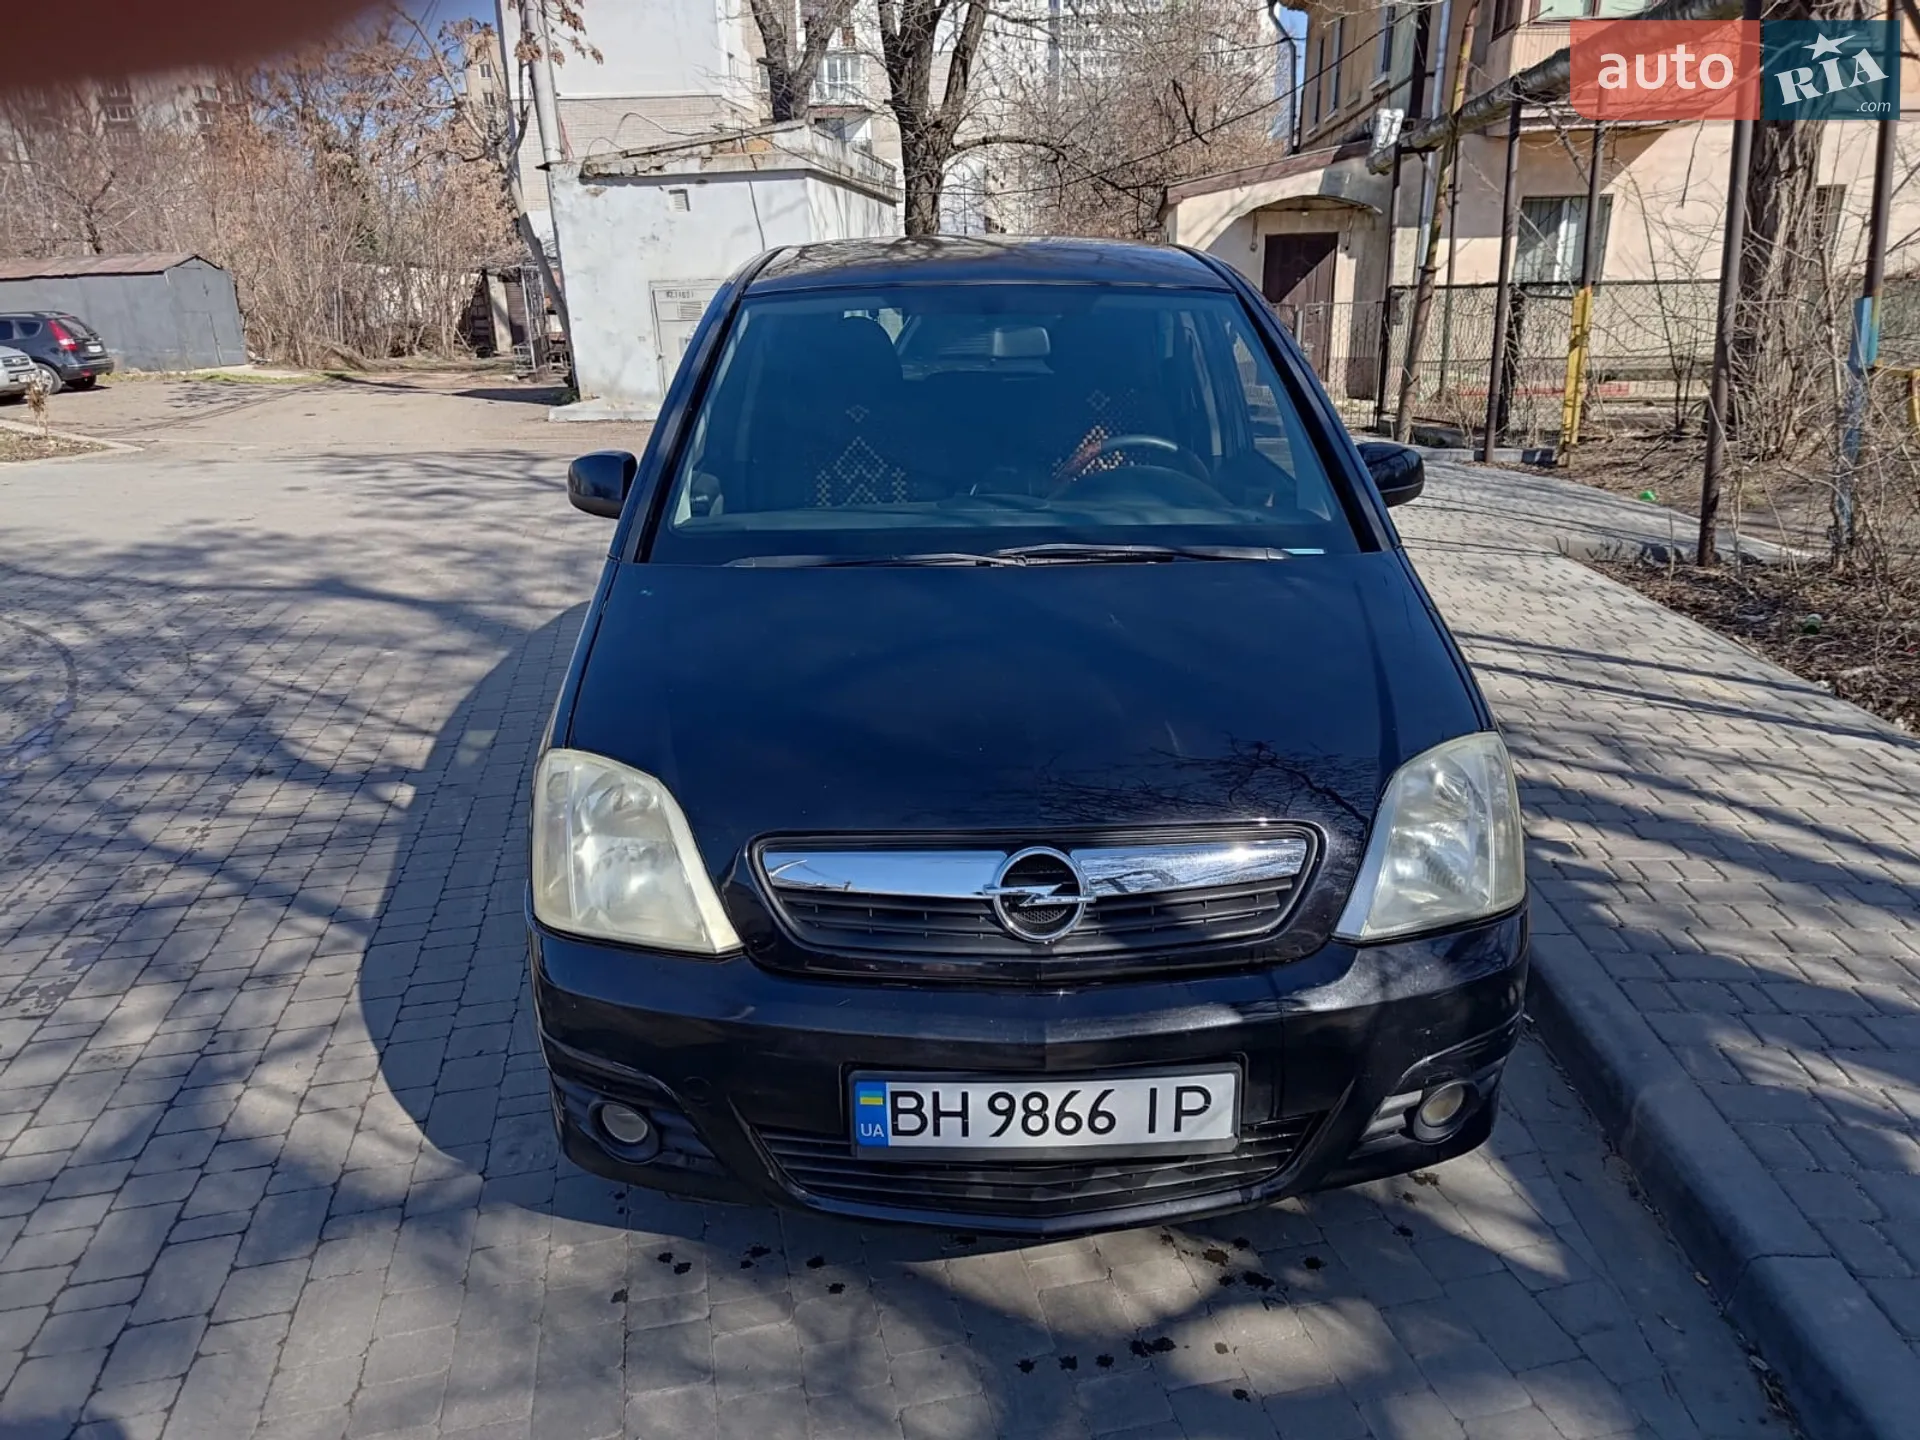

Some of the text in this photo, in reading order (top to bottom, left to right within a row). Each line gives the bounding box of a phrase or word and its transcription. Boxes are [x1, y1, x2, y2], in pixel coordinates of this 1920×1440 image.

[889, 1085, 1212, 1138] BH 9866 IP
[860, 1123, 885, 1139] UA
